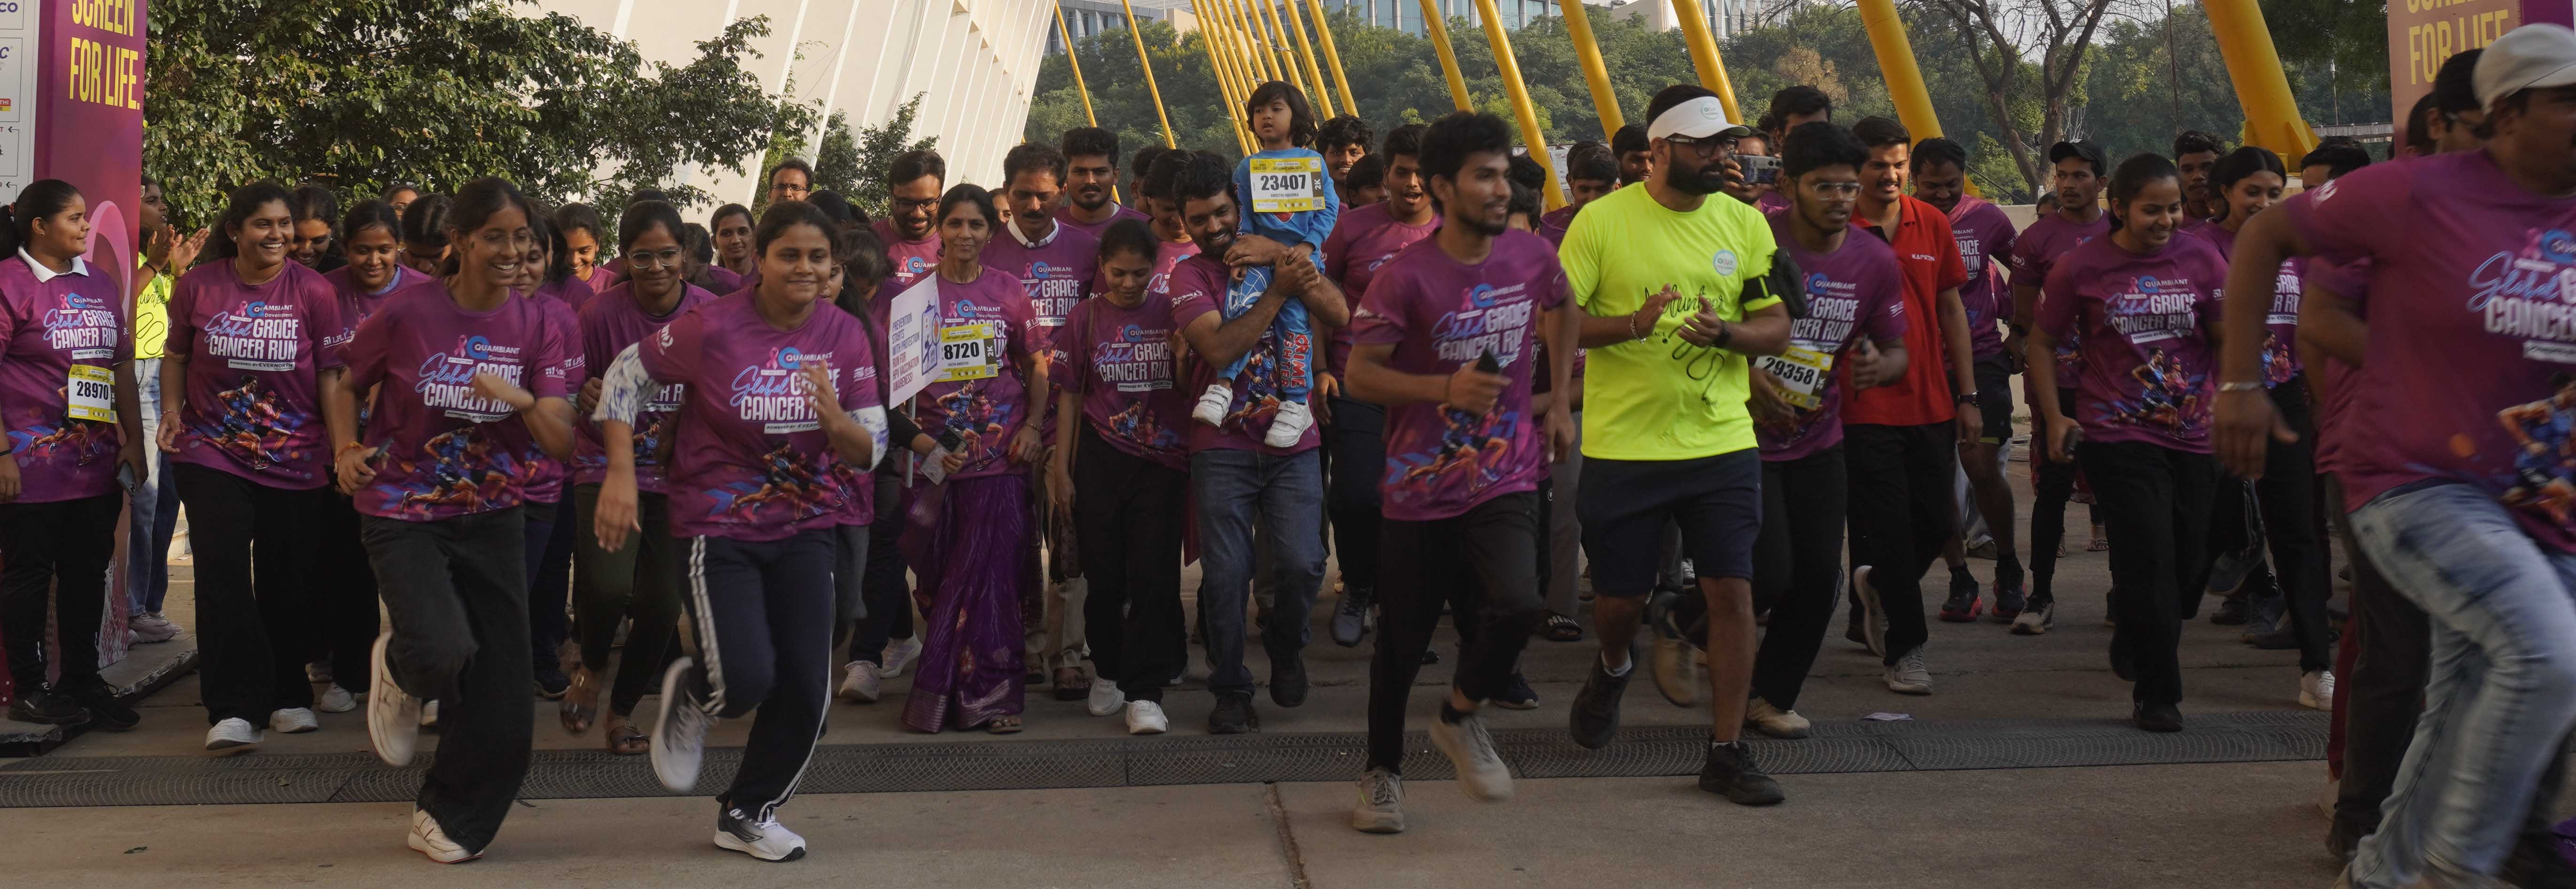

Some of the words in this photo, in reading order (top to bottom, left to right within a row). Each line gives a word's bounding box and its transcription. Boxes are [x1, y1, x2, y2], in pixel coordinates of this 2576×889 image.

[2409, 21, 2452, 85] FOR
[70, 37, 101, 103] FOR
[105, 45, 140, 110] LIFE.
[1261, 174, 1306, 191] 23407
[1315, 179, 1322, 190] 2K
[1956, 240, 1980, 255] ACE
[1042, 279, 1079, 298] GRACE
[2145, 279, 2188, 288] QUAMBIANT
[1032, 298, 1053, 317] CER
[1057, 298, 1079, 315] RUN
[1812, 296, 1860, 321] GRACE
[2150, 293, 2196, 314] GRACE
[82, 310, 117, 328] GRACE
[253, 319, 299, 339] GRACE
[893, 312, 912, 330] PREVENTION
[2112, 314, 2165, 335] CANCER
[53, 328, 99, 350] CANCER
[101, 328, 117, 348] RUN
[892, 329, 905, 344] STARTS
[1791, 318, 1823, 339] CER
[1823, 320, 1854, 342] RUN
[209, 335, 264, 359] CANCER
[268, 340, 298, 360] RUN
[474, 343, 520, 354] QUAMBIANT
[901, 331, 920, 351] PROTECTION
[942, 342, 979, 360] 8720
[994, 339, 1007, 358] UN
[987, 346, 993, 357] 2K
[1094, 342, 1134, 373] Global
[1280, 330, 1295, 388] FGHTER
[1291, 334, 1310, 388] CRIME
[415, 352, 476, 393] Global
[1100, 362, 1147, 382] CANCER
[1151, 361, 1172, 379] RUN
[1762, 357, 1815, 385] 29358
[77, 381, 109, 400] 28970
[730, 366, 790, 407] Global
[791, 368, 841, 396] GRE
[740, 396, 805, 421] CANCER
